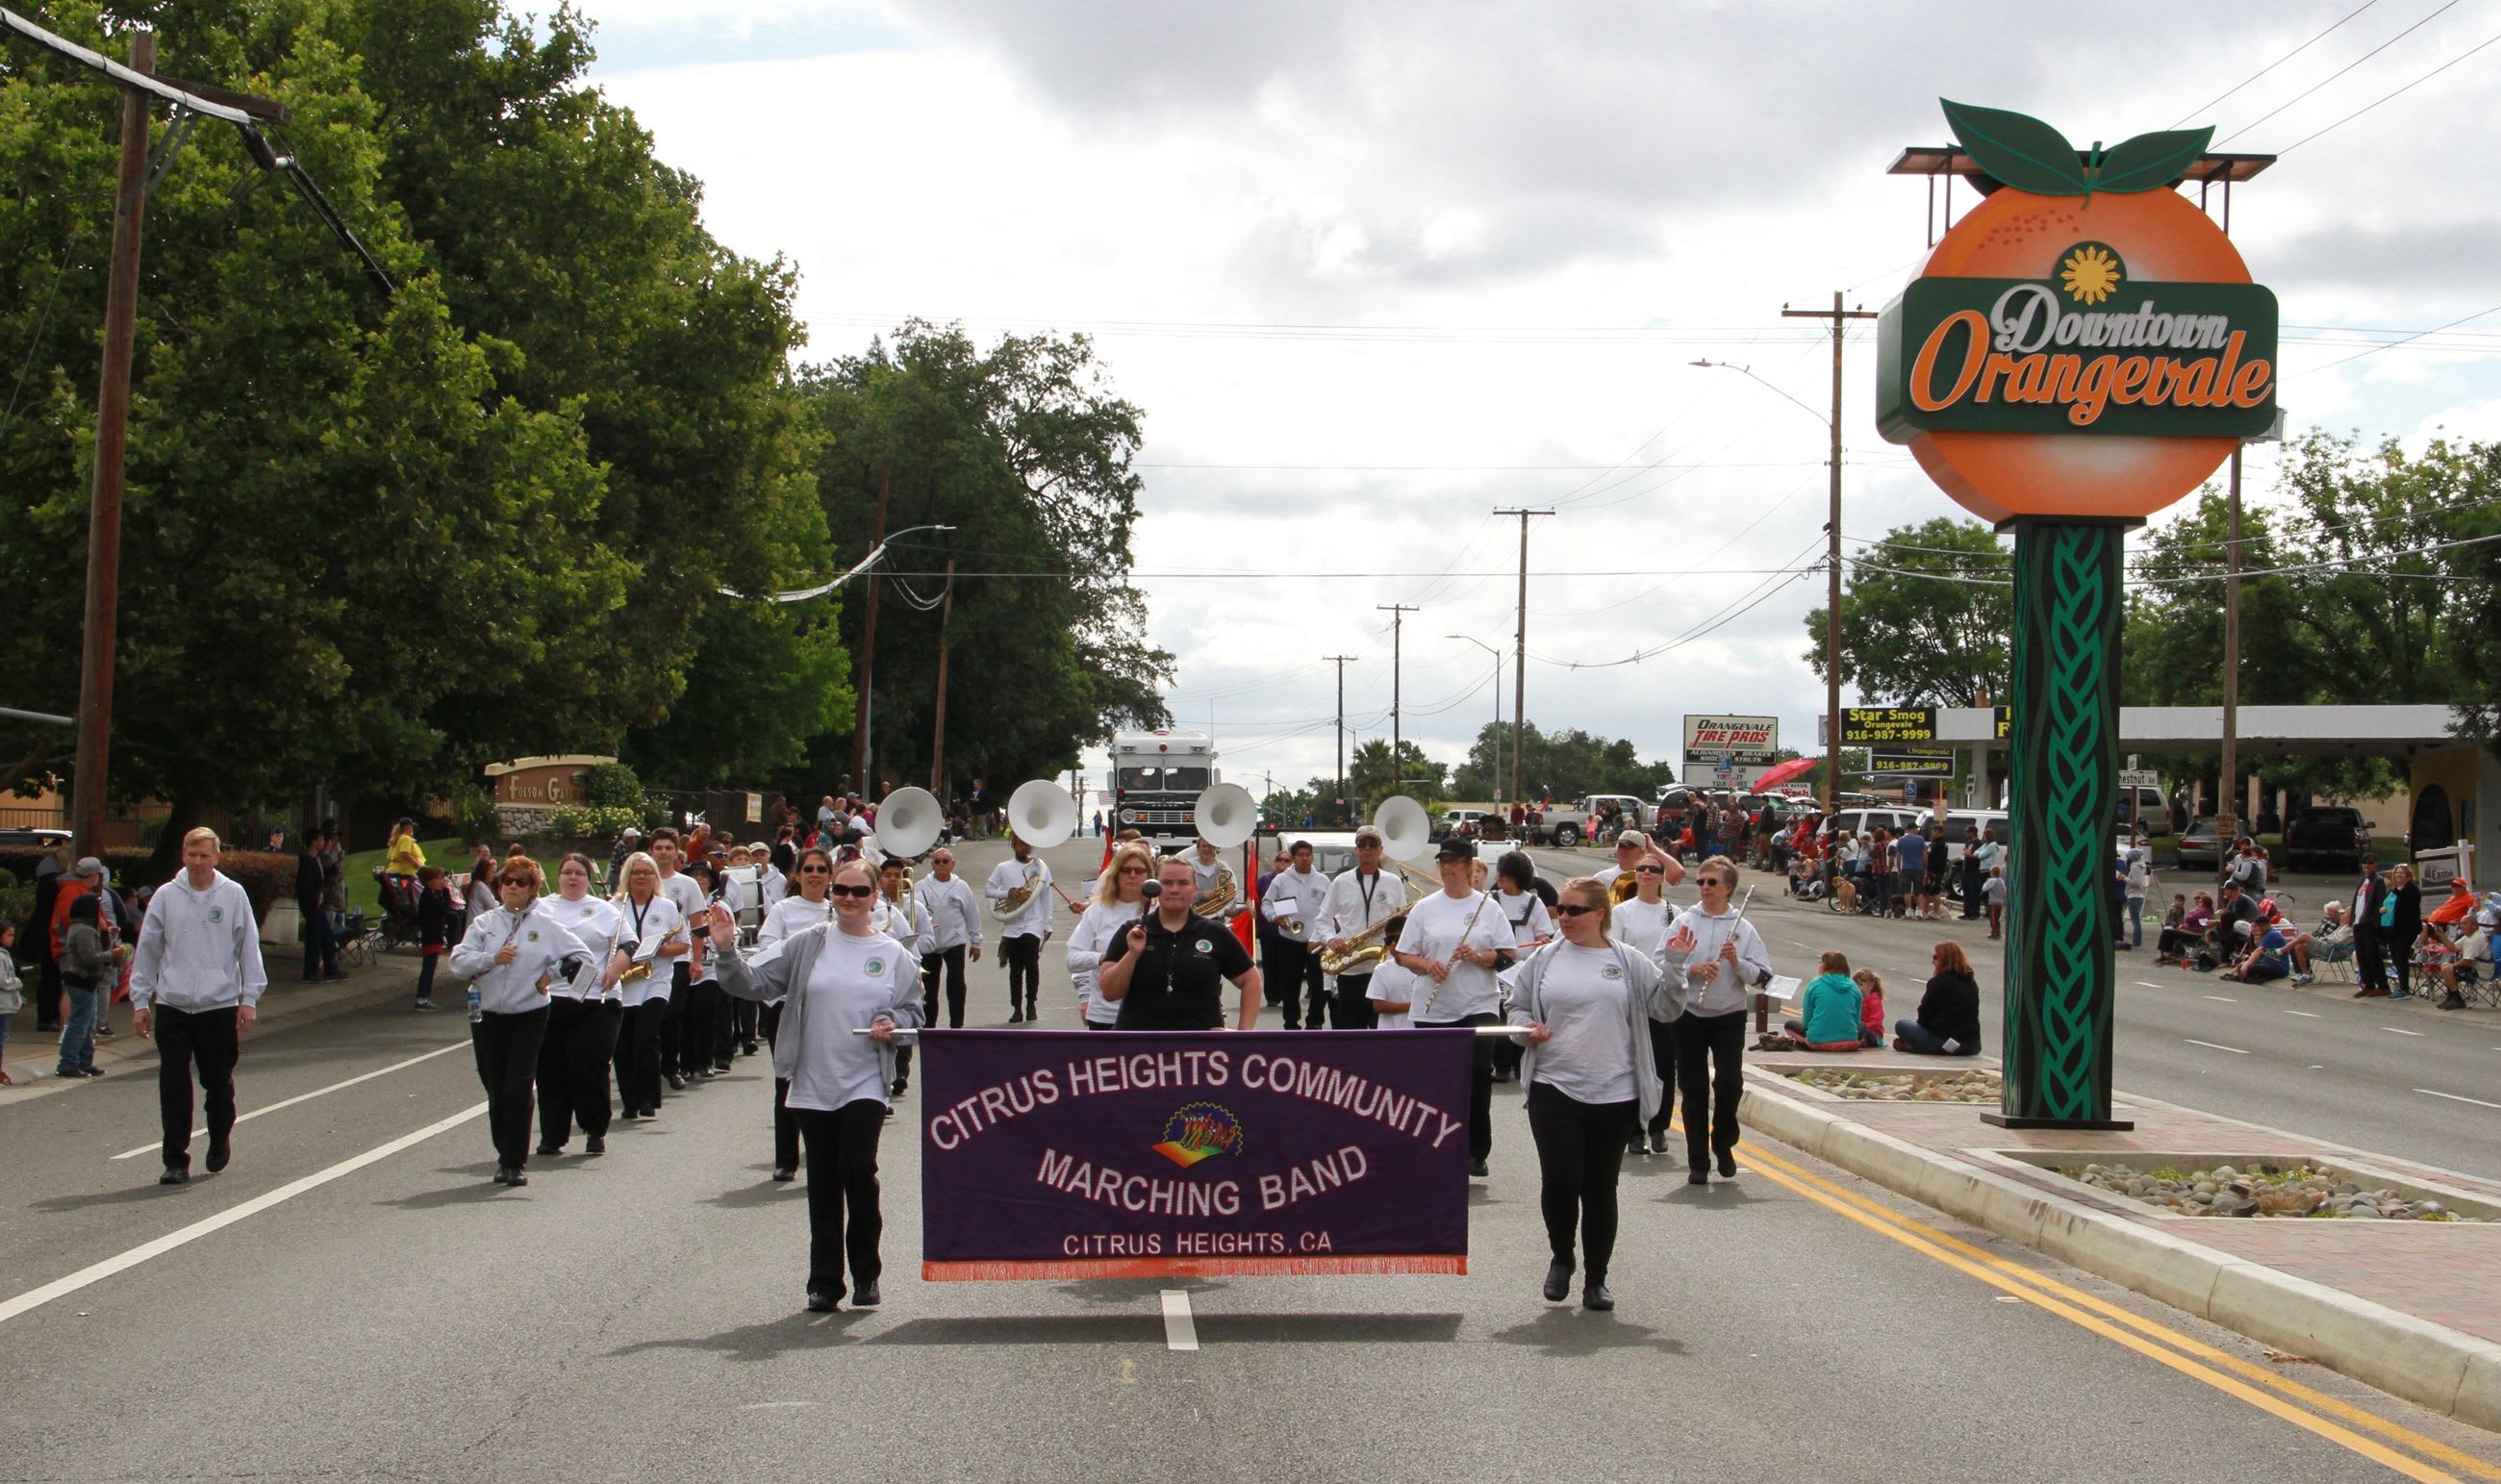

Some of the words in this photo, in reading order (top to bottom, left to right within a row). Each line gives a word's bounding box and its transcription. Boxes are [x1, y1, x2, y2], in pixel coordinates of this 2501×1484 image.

[1990, 284, 2229, 354] Downtown
[1909, 309, 2275, 426] Orangevale
[1698, 719, 1774, 731] ORANGEVALE
[1849, 709, 1883, 721] Star
[1888, 710, 1926, 723] Smog
[1864, 721, 1913, 730] Orangevale
[1693, 730, 1727, 748] TIRE
[1725, 731, 1769, 749] PROS
[1846, 729, 1932, 741] 916-987-9999
[2119, 774, 2145, 784] hestnut
[930, 1069, 1059, 1150] CITRUS
[1068, 1051, 1229, 1096] HEIGHTS
[1242, 1053, 1462, 1148] COMMUNITY
[1037, 1147, 1240, 1217] MARCHING
[1258, 1145, 1368, 1211] BAND
[1064, 1233, 1162, 1255] CITRUS
[1176, 1232, 1293, 1255] HEIGHTS,
[1301, 1231, 1332, 1252] CA
